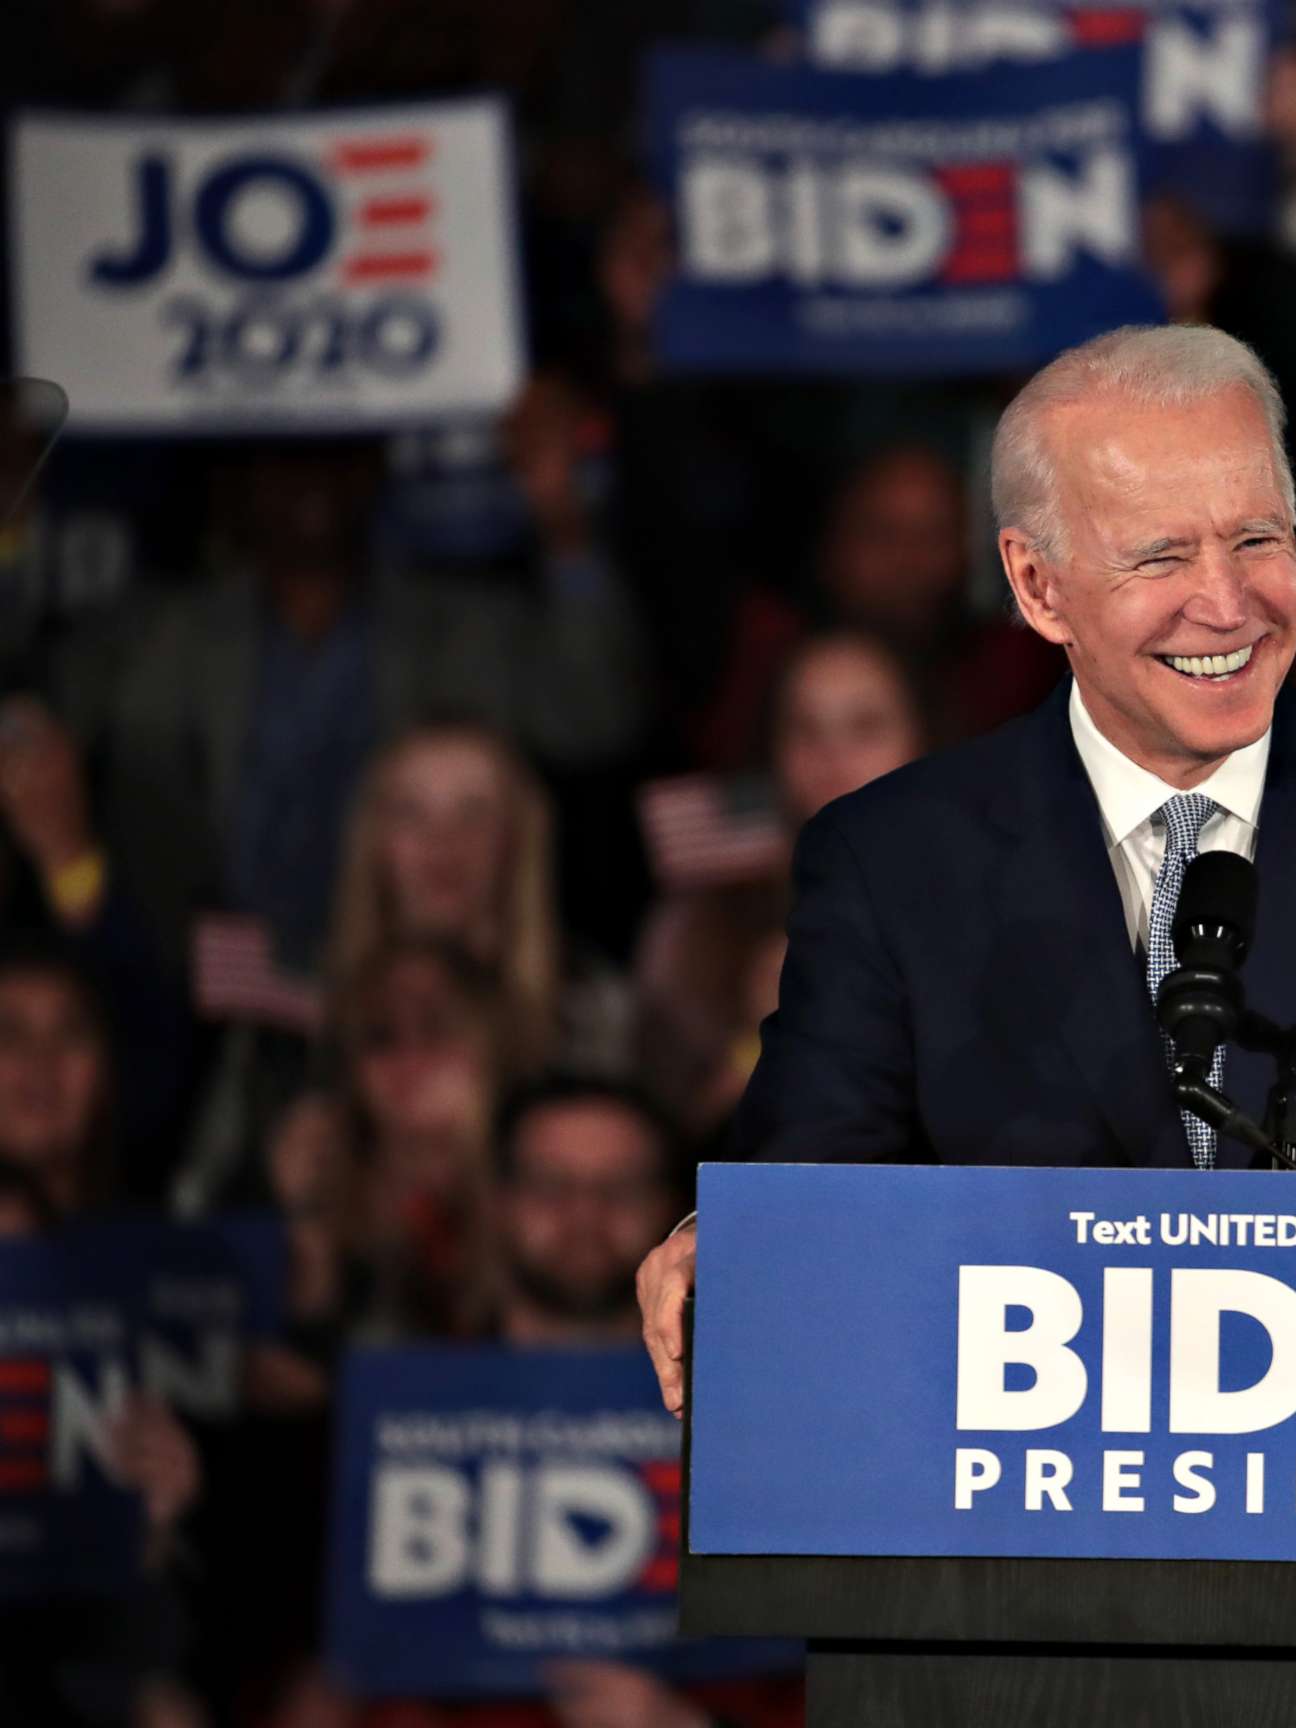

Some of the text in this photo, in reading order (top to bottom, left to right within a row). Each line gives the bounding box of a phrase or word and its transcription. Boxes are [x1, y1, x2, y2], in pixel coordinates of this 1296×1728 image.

[88, 132, 438, 290] JOE
[682, 152, 1135, 287] BIDEN
[166, 298, 442, 384] 2020
[1070, 1212, 1151, 1245] Text
